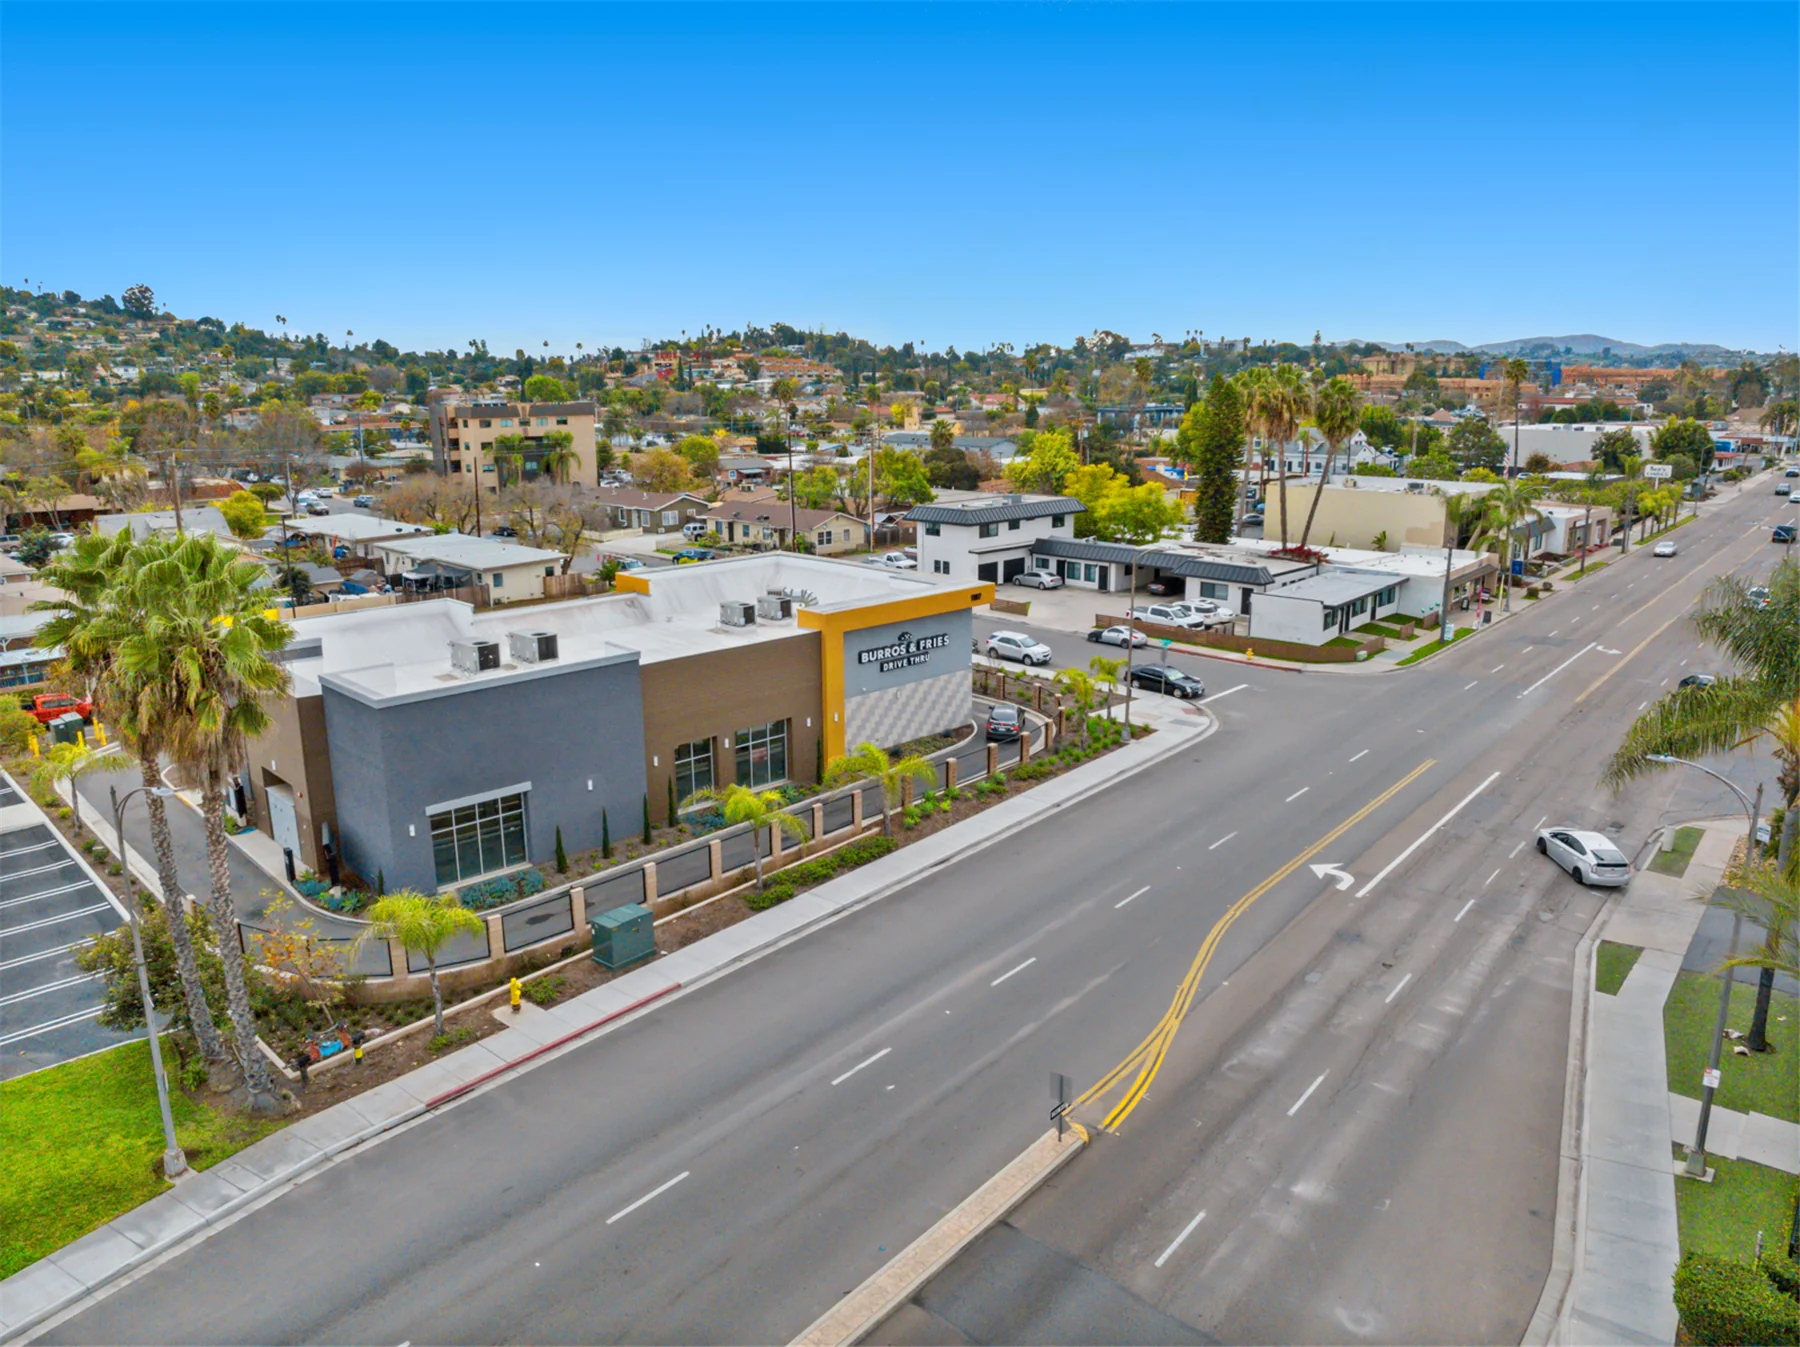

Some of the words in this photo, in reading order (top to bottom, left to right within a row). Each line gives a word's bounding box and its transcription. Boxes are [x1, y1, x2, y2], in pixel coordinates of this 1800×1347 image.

[861, 644, 906, 663] BURROS
[908, 641, 917, 653] &
[920, 635, 950, 650] FRIES
[883, 658, 908, 672] DRIVE
[910, 653, 930, 665] THRU
